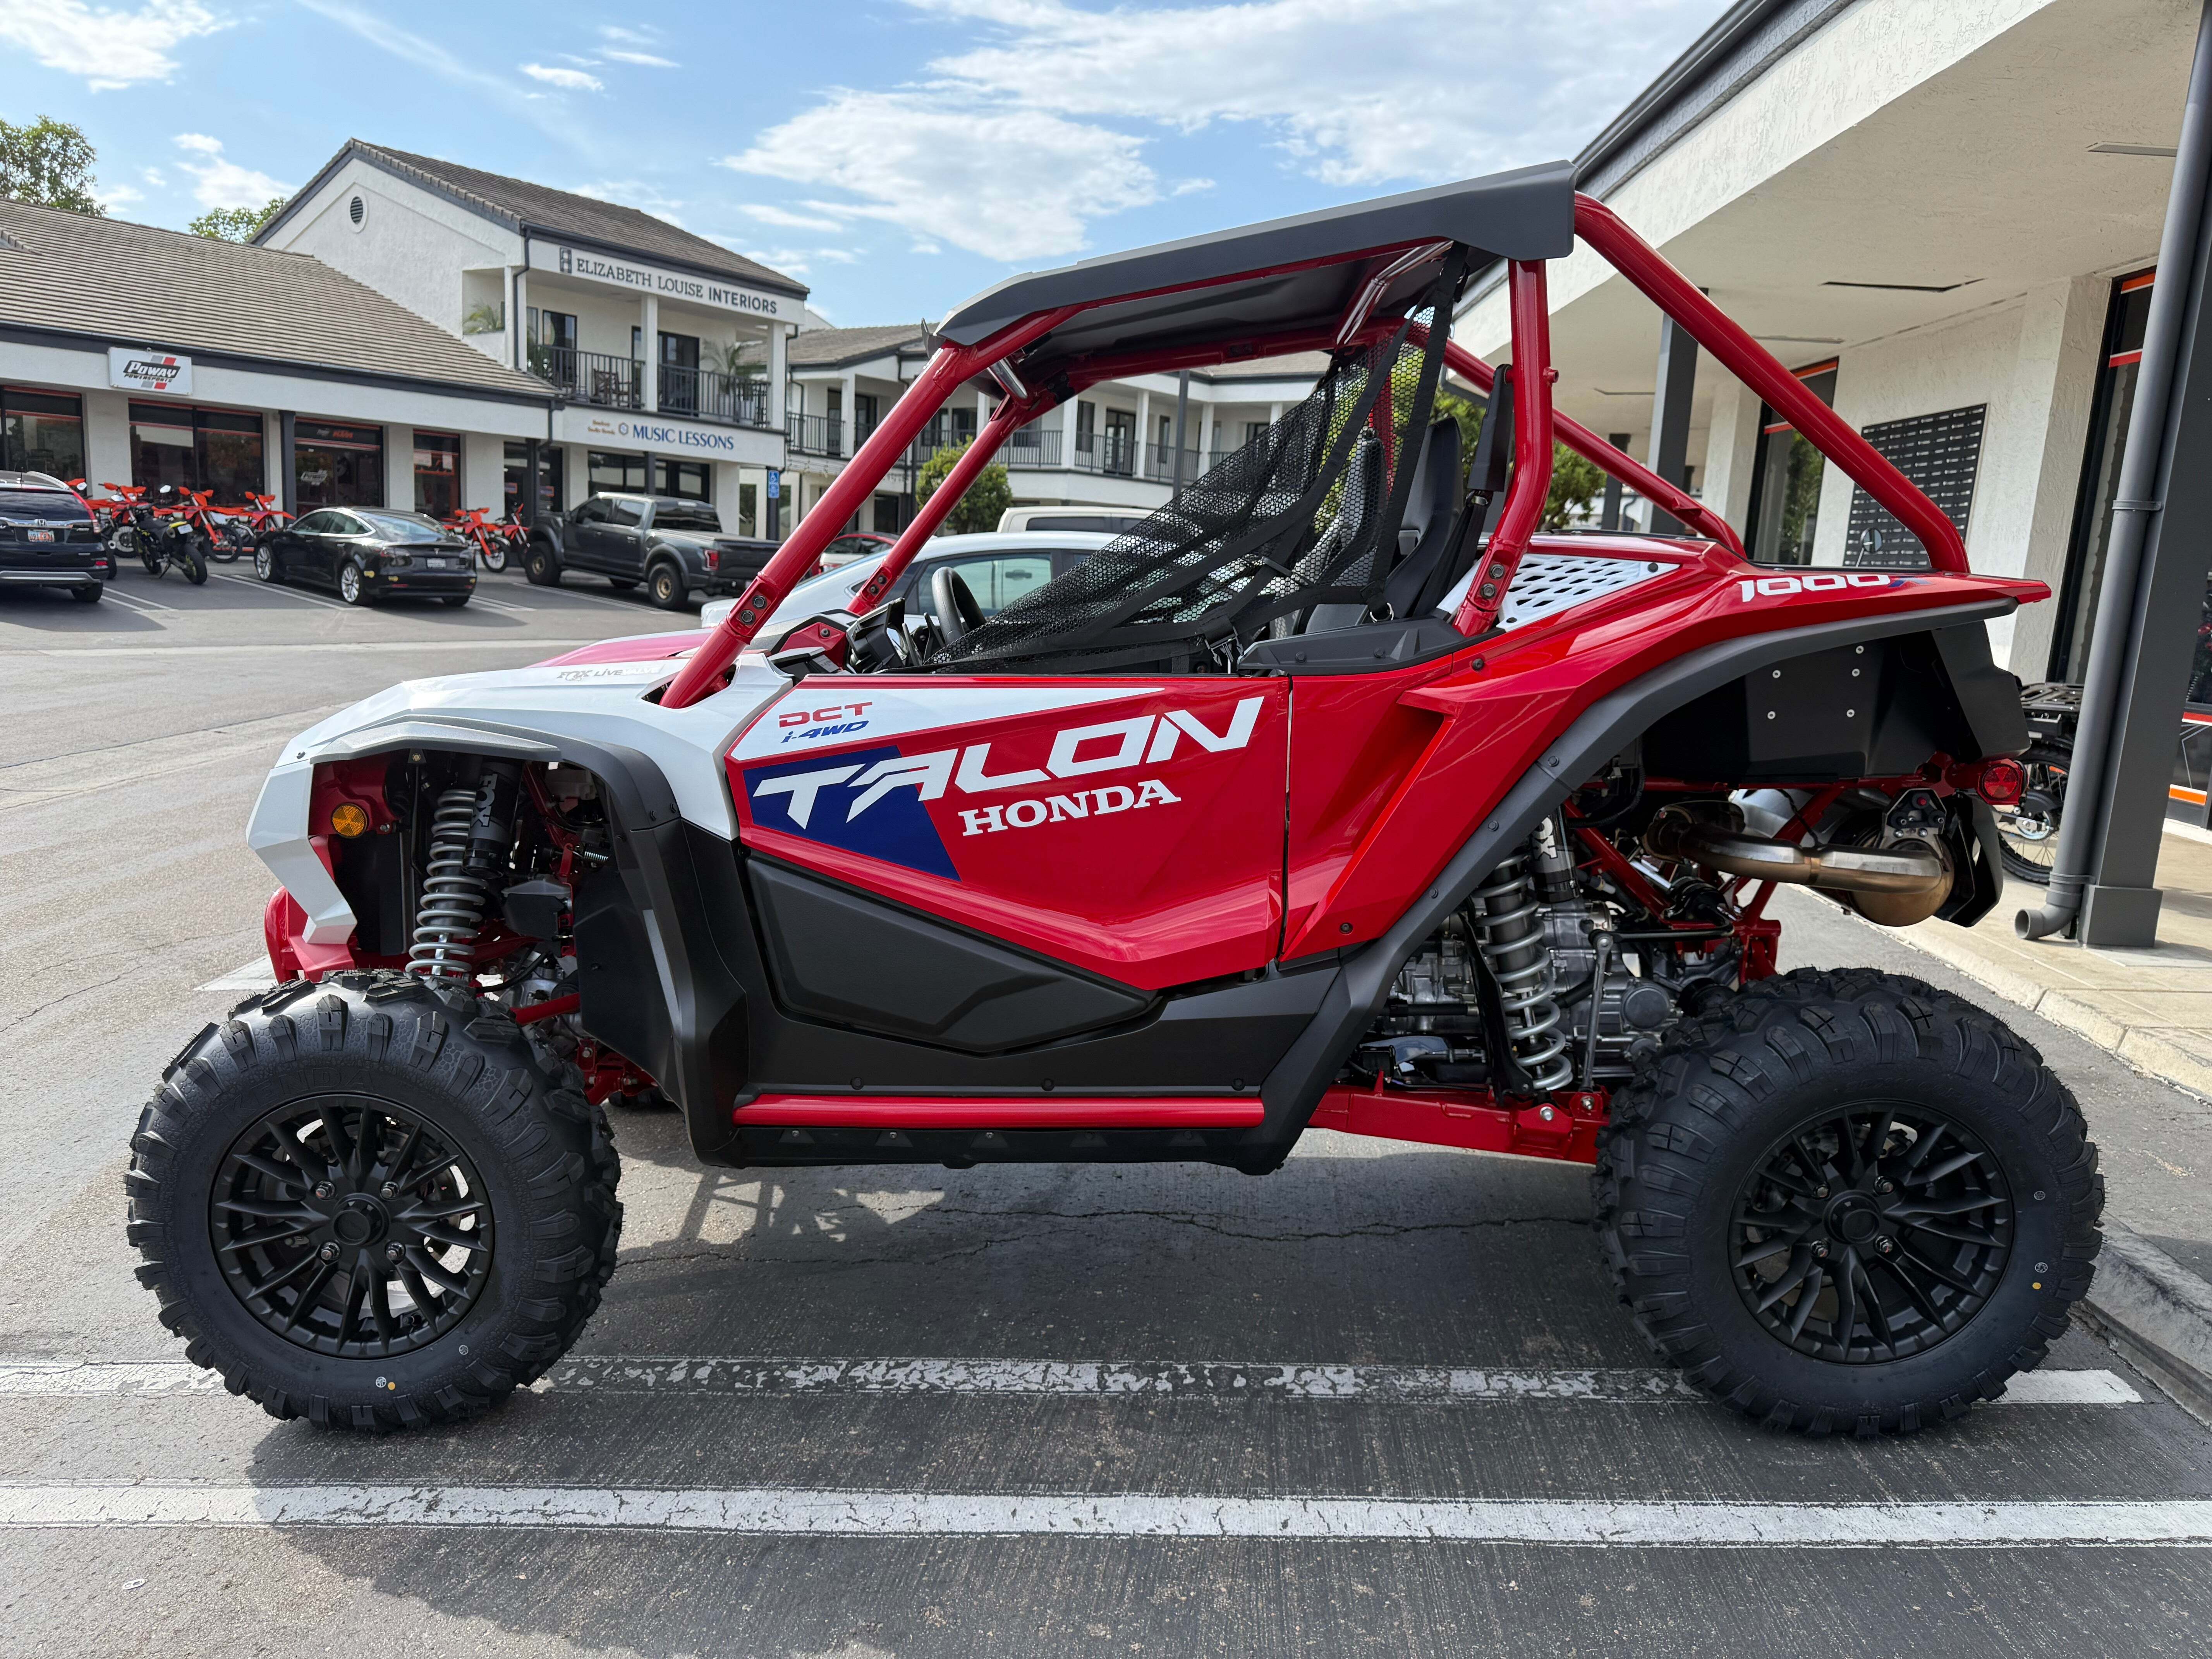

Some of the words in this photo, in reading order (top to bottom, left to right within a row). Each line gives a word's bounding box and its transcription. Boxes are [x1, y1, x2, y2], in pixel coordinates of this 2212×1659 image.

[577, 258, 652, 287] ELIZABETH
[658, 276, 703, 298] LOUISE
[709, 287, 777, 314] INTERIORS
[127, 362, 177, 377] POWAY
[633, 424, 676, 443] MUSIC
[679, 431, 735, 450] LESSONS
[778, 702, 873, 728] DCT
[780, 720, 869, 743] i-4WD
[752, 696, 1265, 830] TALON
[471, 773, 498, 827] FOX
[958, 779, 1182, 836] HONDA
[1531, 817, 1557, 859] OX
